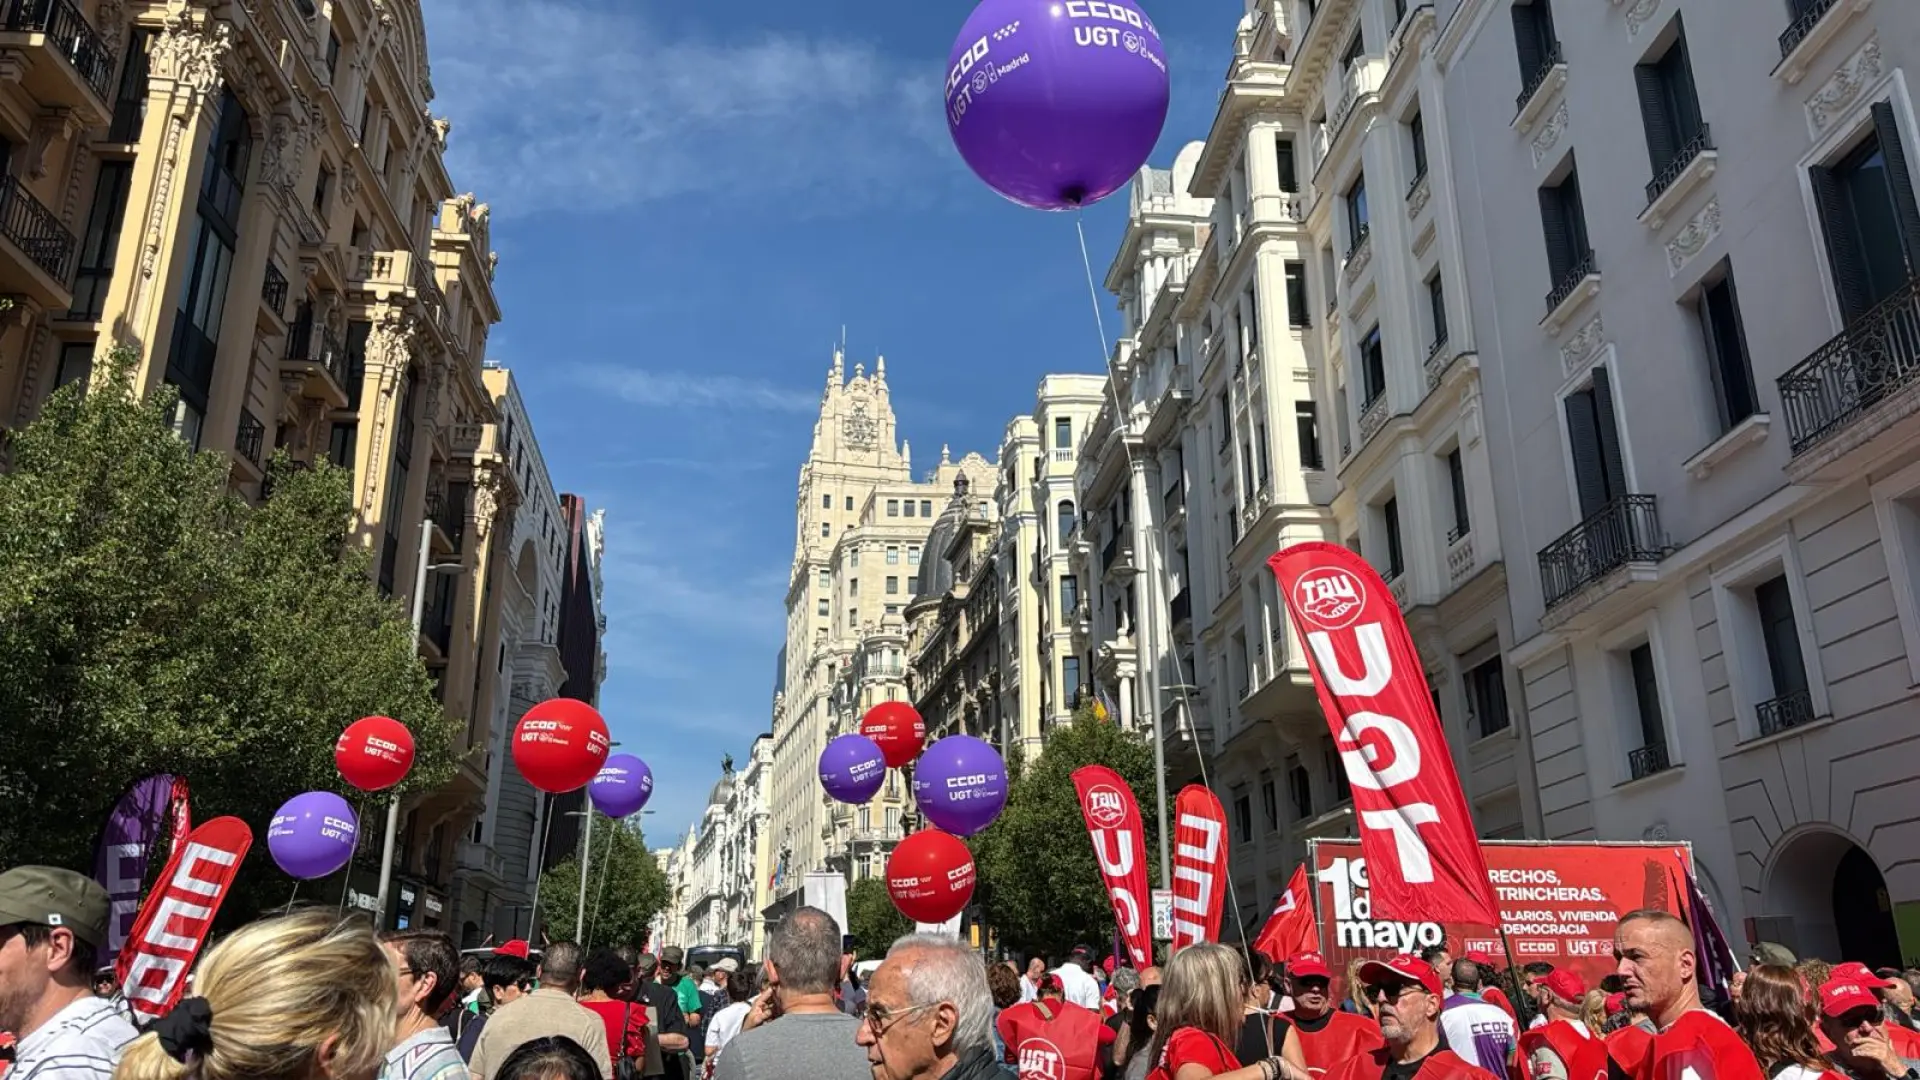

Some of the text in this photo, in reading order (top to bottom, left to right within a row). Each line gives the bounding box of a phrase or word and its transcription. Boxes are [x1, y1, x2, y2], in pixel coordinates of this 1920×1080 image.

[1066, 1, 1143, 29] CCOO
[1074, 26, 1120, 47] UGT
[951, 52, 1029, 126] UGT Madrid
[523, 720, 557, 731] CCOO
[367, 736, 397, 752] CCOO
[521, 732, 539, 742] UGT
[364, 745, 383, 757] UGT
[849, 760, 876, 774] CCOO
[947, 774, 985, 788] CCOO
[949, 789, 972, 801] UGT
[324, 816, 355, 833] CCOO
[321, 827, 341, 839] UGT
[947, 862, 972, 880] CCOO
[1488, 869, 1561, 886] RECHOS,
[891, 877, 919, 887] CCOO
[1496, 887, 1606, 901] TRINCHERAS.
[1500, 911, 1619, 923] ALARIOS, VIVIENDA
[123, 842, 237, 1025] CCO
[1503, 924, 1589, 935] DEMOCRACIA
[1336, 920, 1443, 955] mayo
[1467, 941, 1598, 955] UGT CCOO UGT
[1470, 1022, 1509, 1035] CCOO
[1019, 1048, 1057, 1078] UGT
